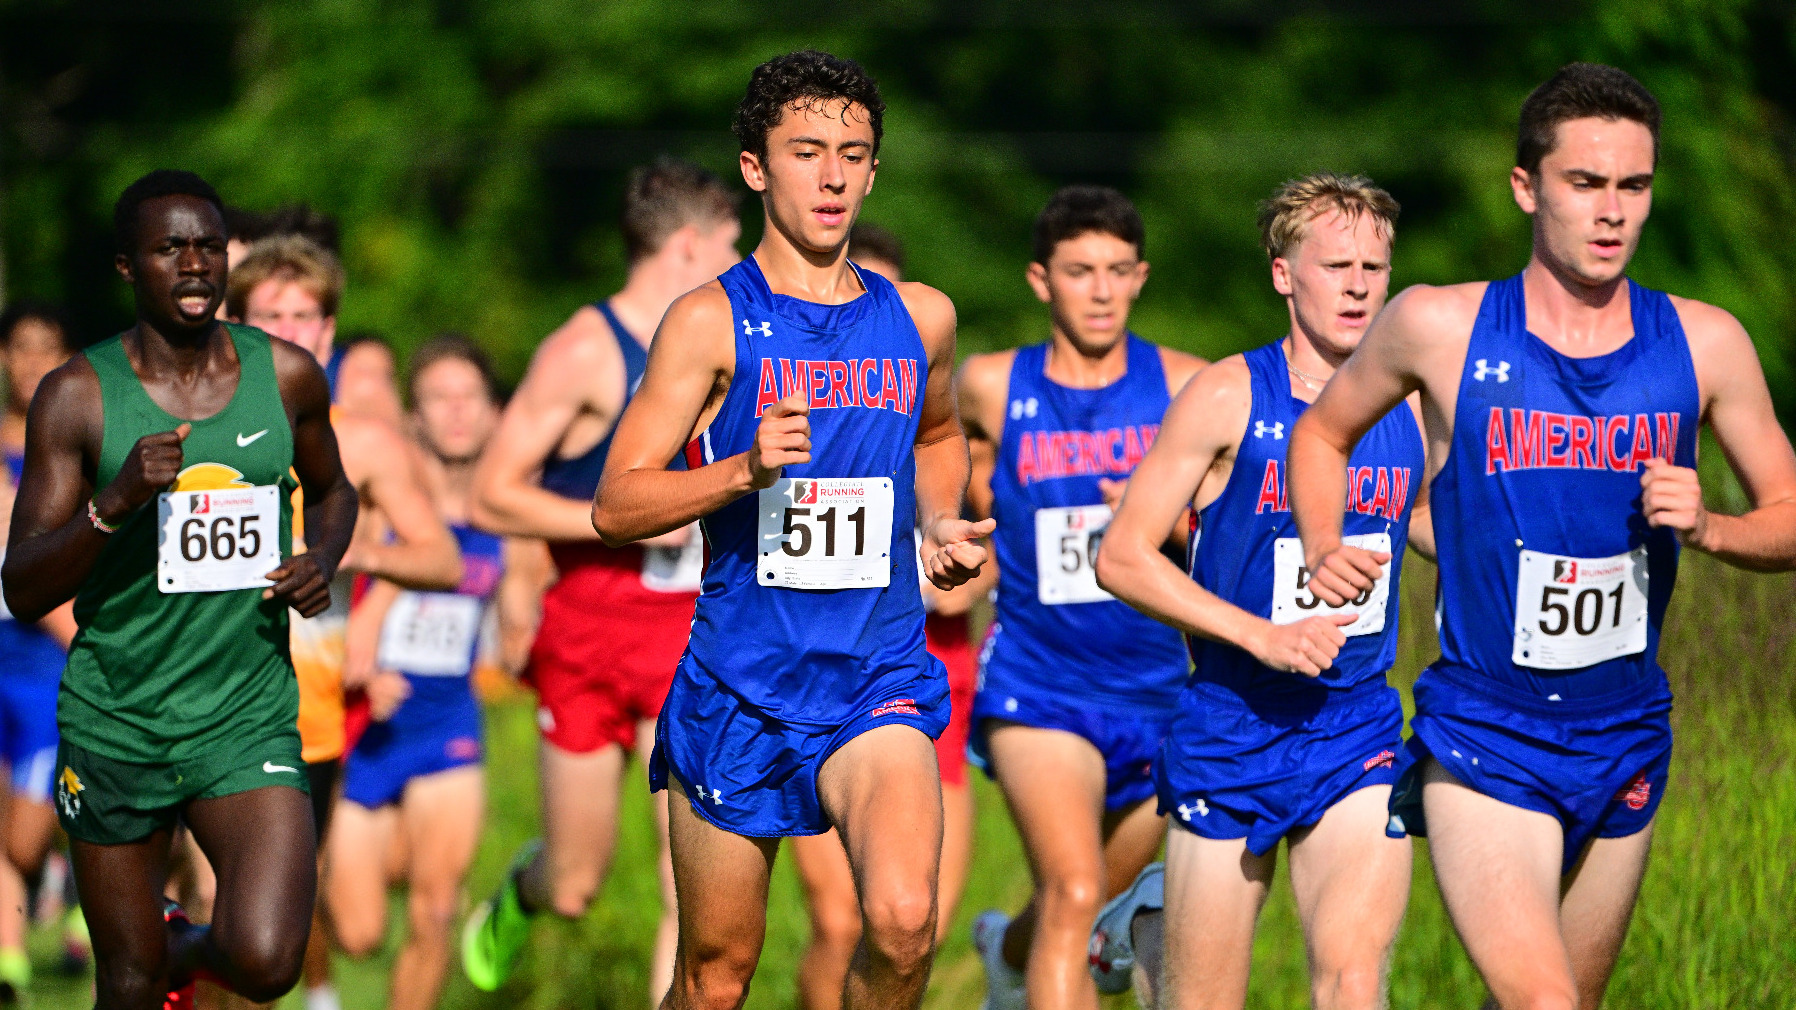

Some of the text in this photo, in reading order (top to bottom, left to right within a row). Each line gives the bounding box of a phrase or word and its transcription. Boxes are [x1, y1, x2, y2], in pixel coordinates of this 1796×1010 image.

[755, 358, 917, 418] AMERICAN
[1486, 407, 1680, 475] AMERICAN
[820, 487, 865, 497] RUNNING
[1255, 459, 1411, 522] AICAN
[180, 515, 261, 562] 665
[781, 507, 865, 557] 511
[1538, 581, 1625, 636] 501
